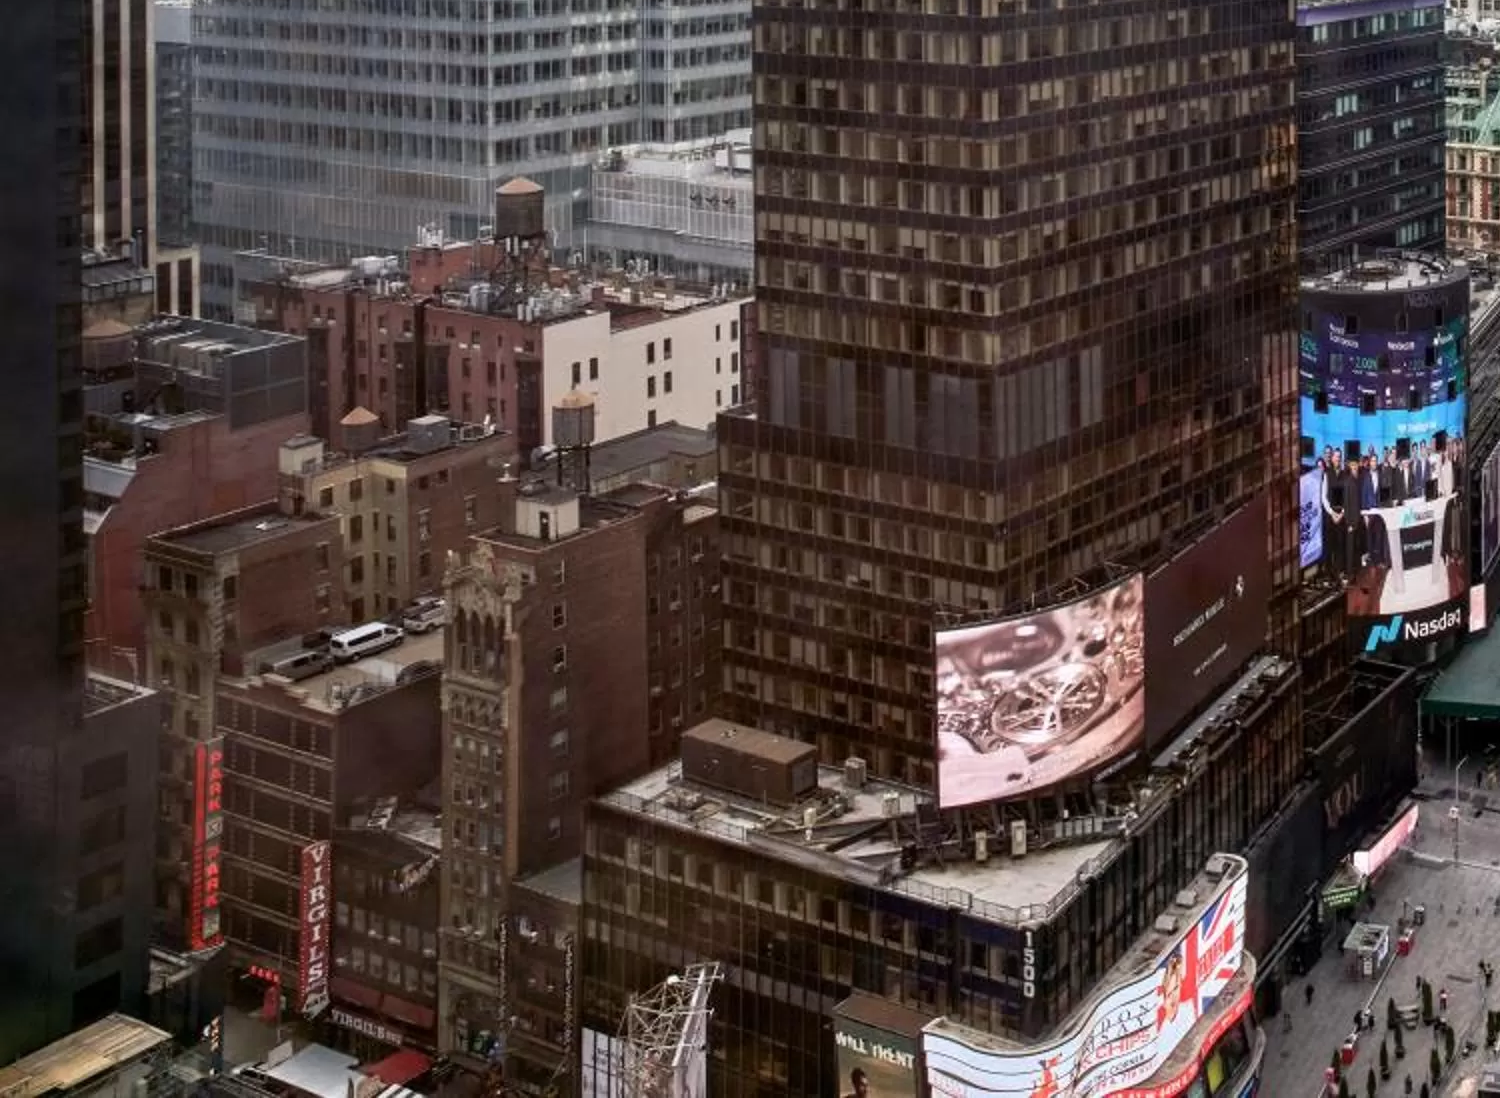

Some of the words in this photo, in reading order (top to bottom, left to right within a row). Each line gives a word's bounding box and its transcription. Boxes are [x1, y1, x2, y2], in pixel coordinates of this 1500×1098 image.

[1404, 607, 1461, 641] Nasdaq
[1023, 931, 1036, 999] 1500
[836, 1031, 868, 1055] WILL
[873, 1043, 915, 1070] TRENT
